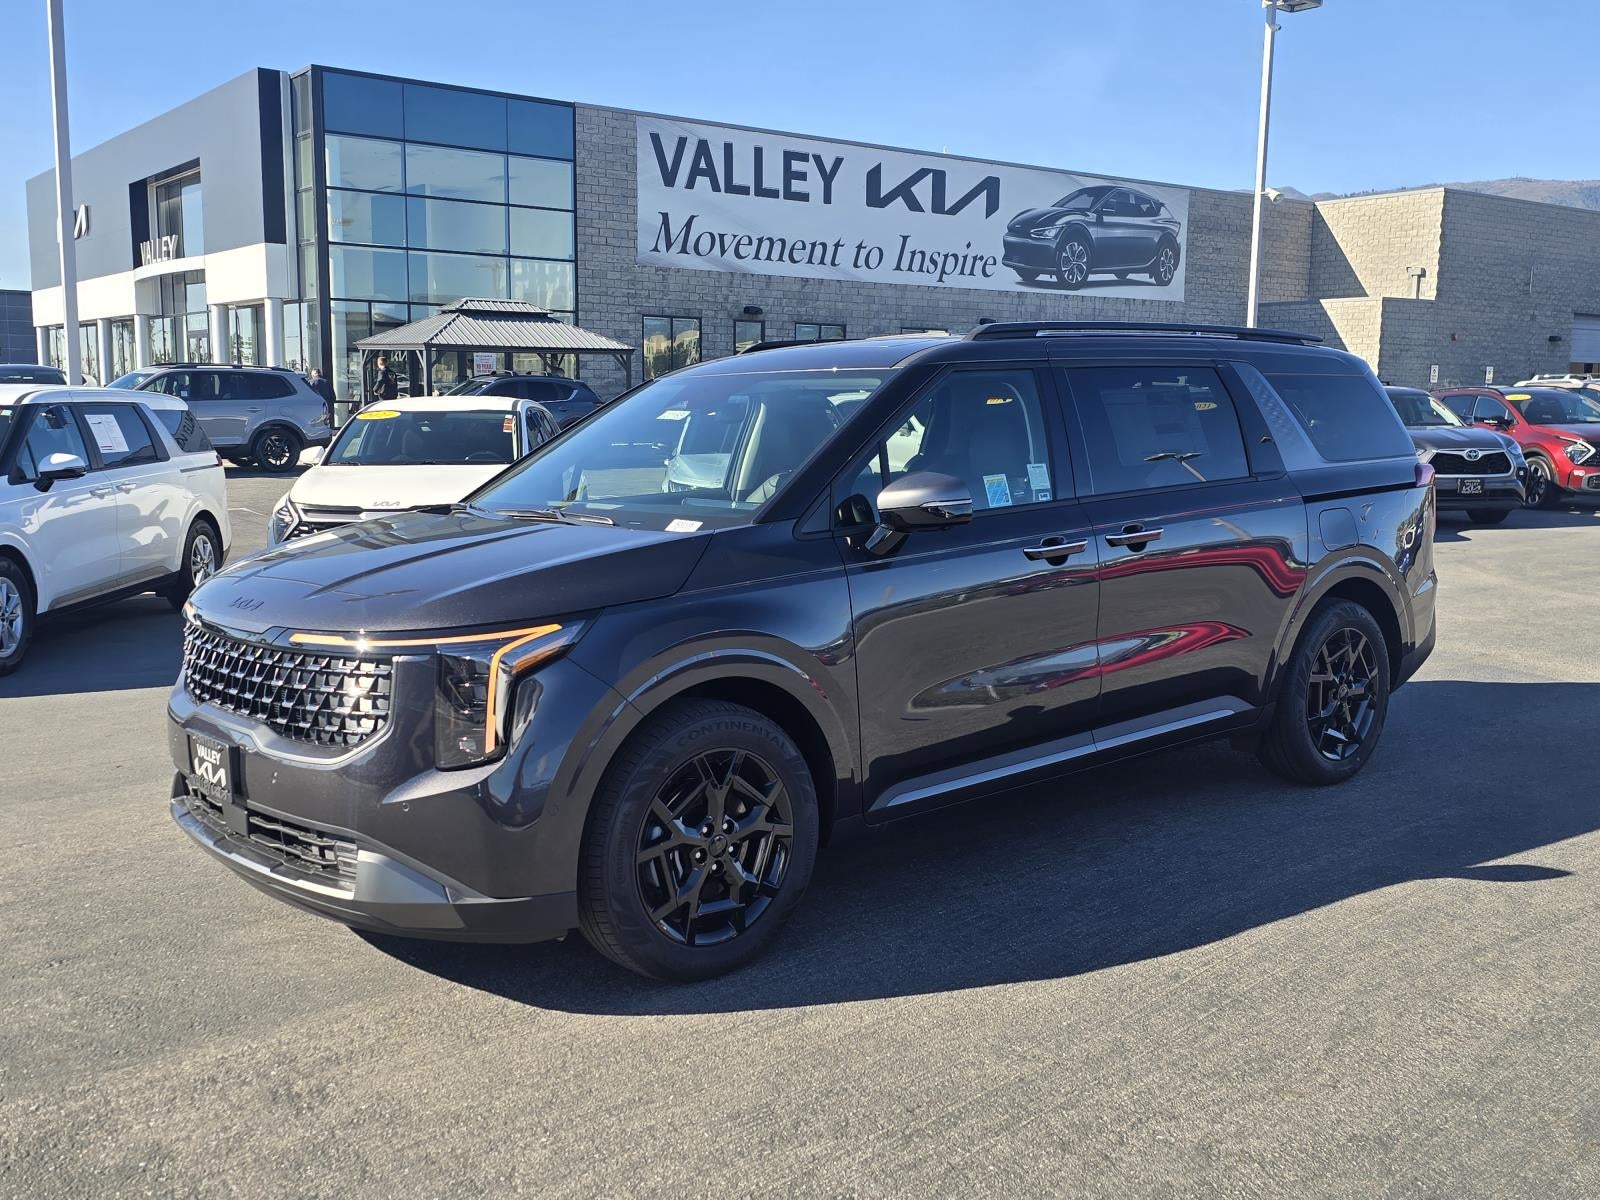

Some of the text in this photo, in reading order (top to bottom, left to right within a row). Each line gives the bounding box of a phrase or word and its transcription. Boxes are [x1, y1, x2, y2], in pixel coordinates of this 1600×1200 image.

[649, 132, 1000, 220] VALLEY KIA
[140, 234, 178, 266] VALLEY
[649, 211, 996, 283] Movement to Inspire
[676, 721, 792, 752] CONTINENTAL
[196, 743, 221, 765] VALLEY
[194, 757, 226, 787] KIA
